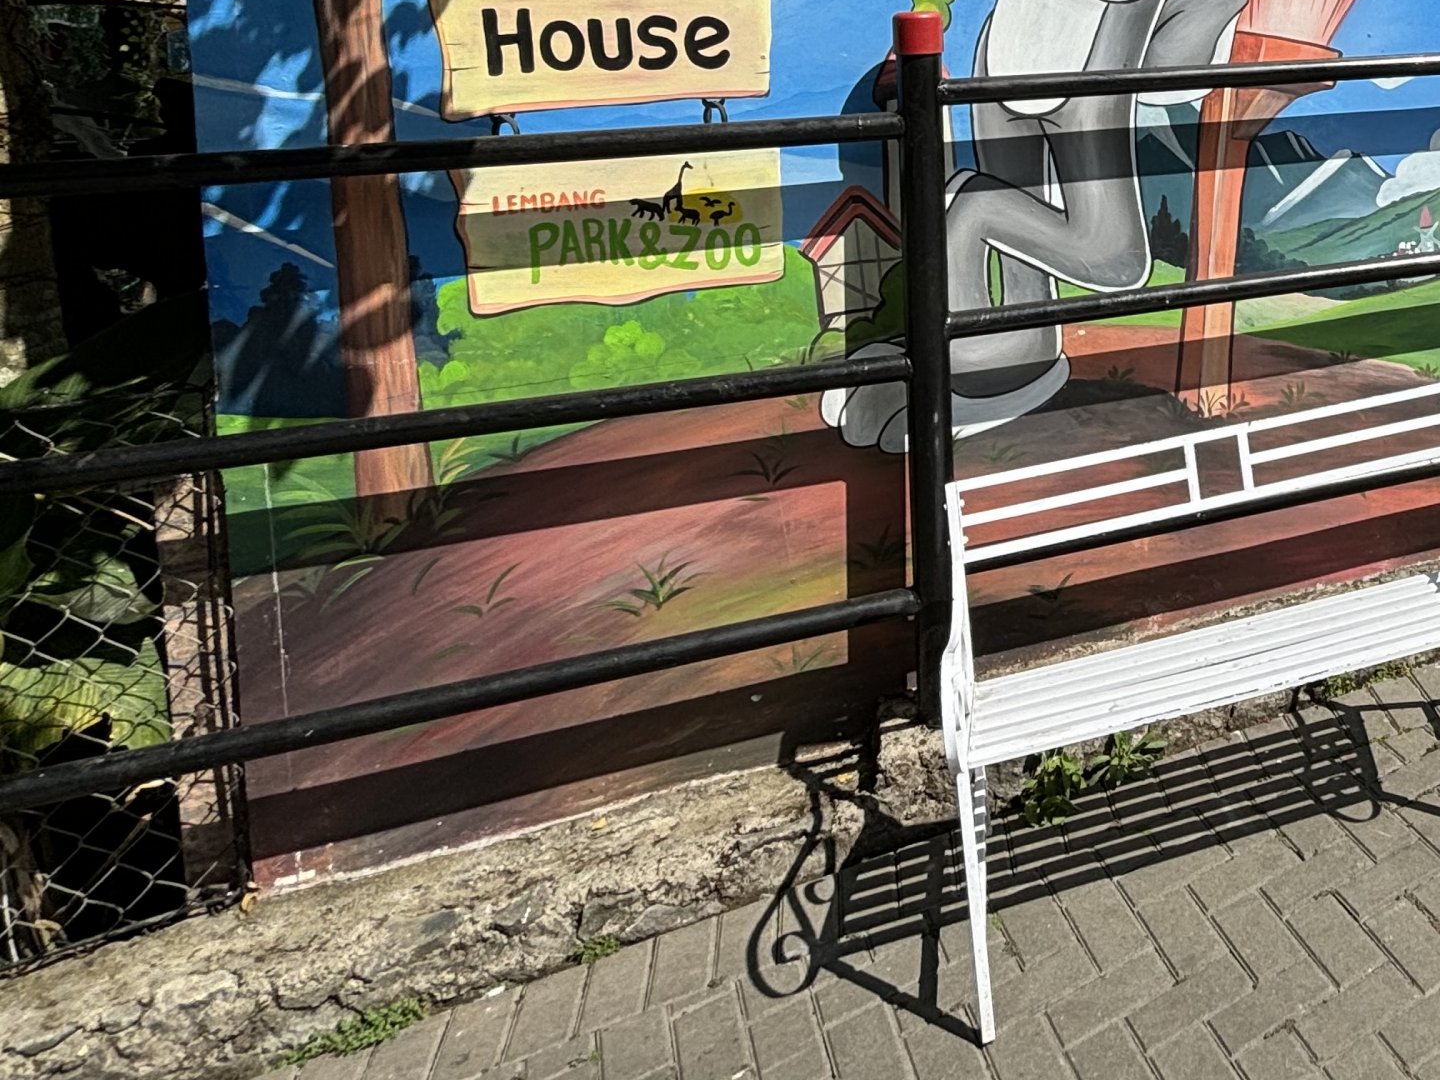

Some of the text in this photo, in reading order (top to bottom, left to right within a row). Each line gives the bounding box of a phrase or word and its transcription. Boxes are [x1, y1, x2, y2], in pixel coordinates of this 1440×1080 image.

[482, 8, 730, 76] House
[492, 189, 606, 216] LEMBANG
[529, 218, 761, 284] PARK&ZOO
